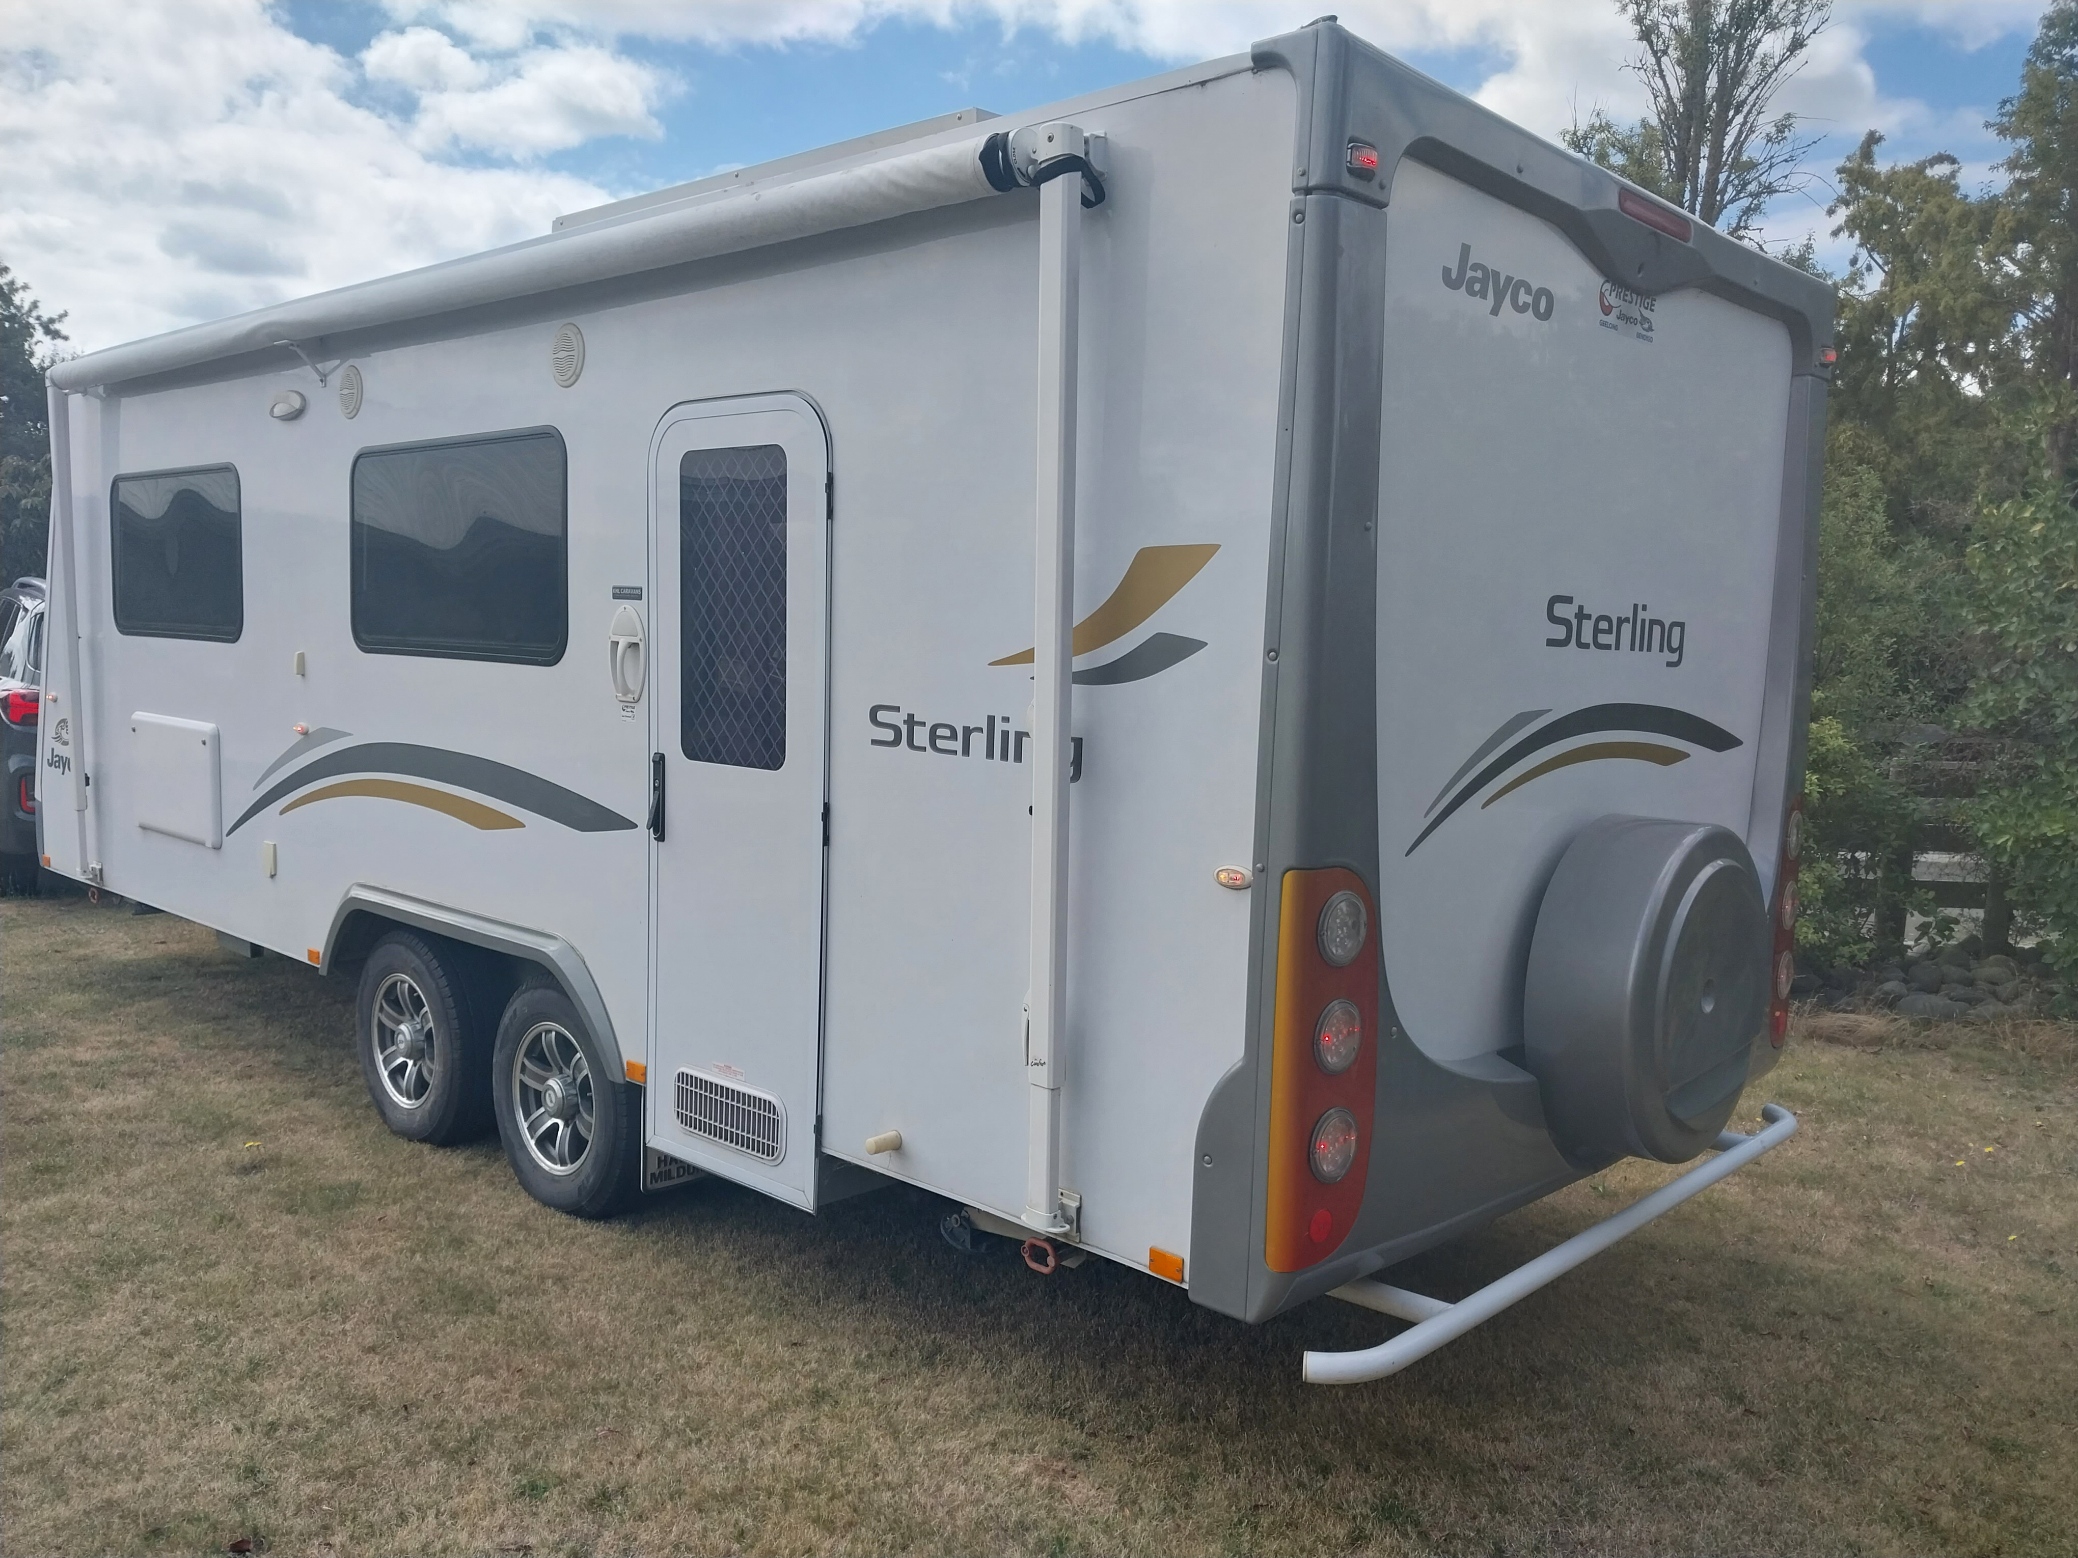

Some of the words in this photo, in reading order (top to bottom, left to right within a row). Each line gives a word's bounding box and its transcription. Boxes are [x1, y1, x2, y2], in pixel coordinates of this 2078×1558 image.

[1442, 242, 1554, 321] Jayco
[1609, 283, 1657, 313] PRESTIGE
[1616, 309, 1638, 326] Jayco
[1546, 595, 1686, 668] Sterling
[47, 747, 71, 776] Jay
